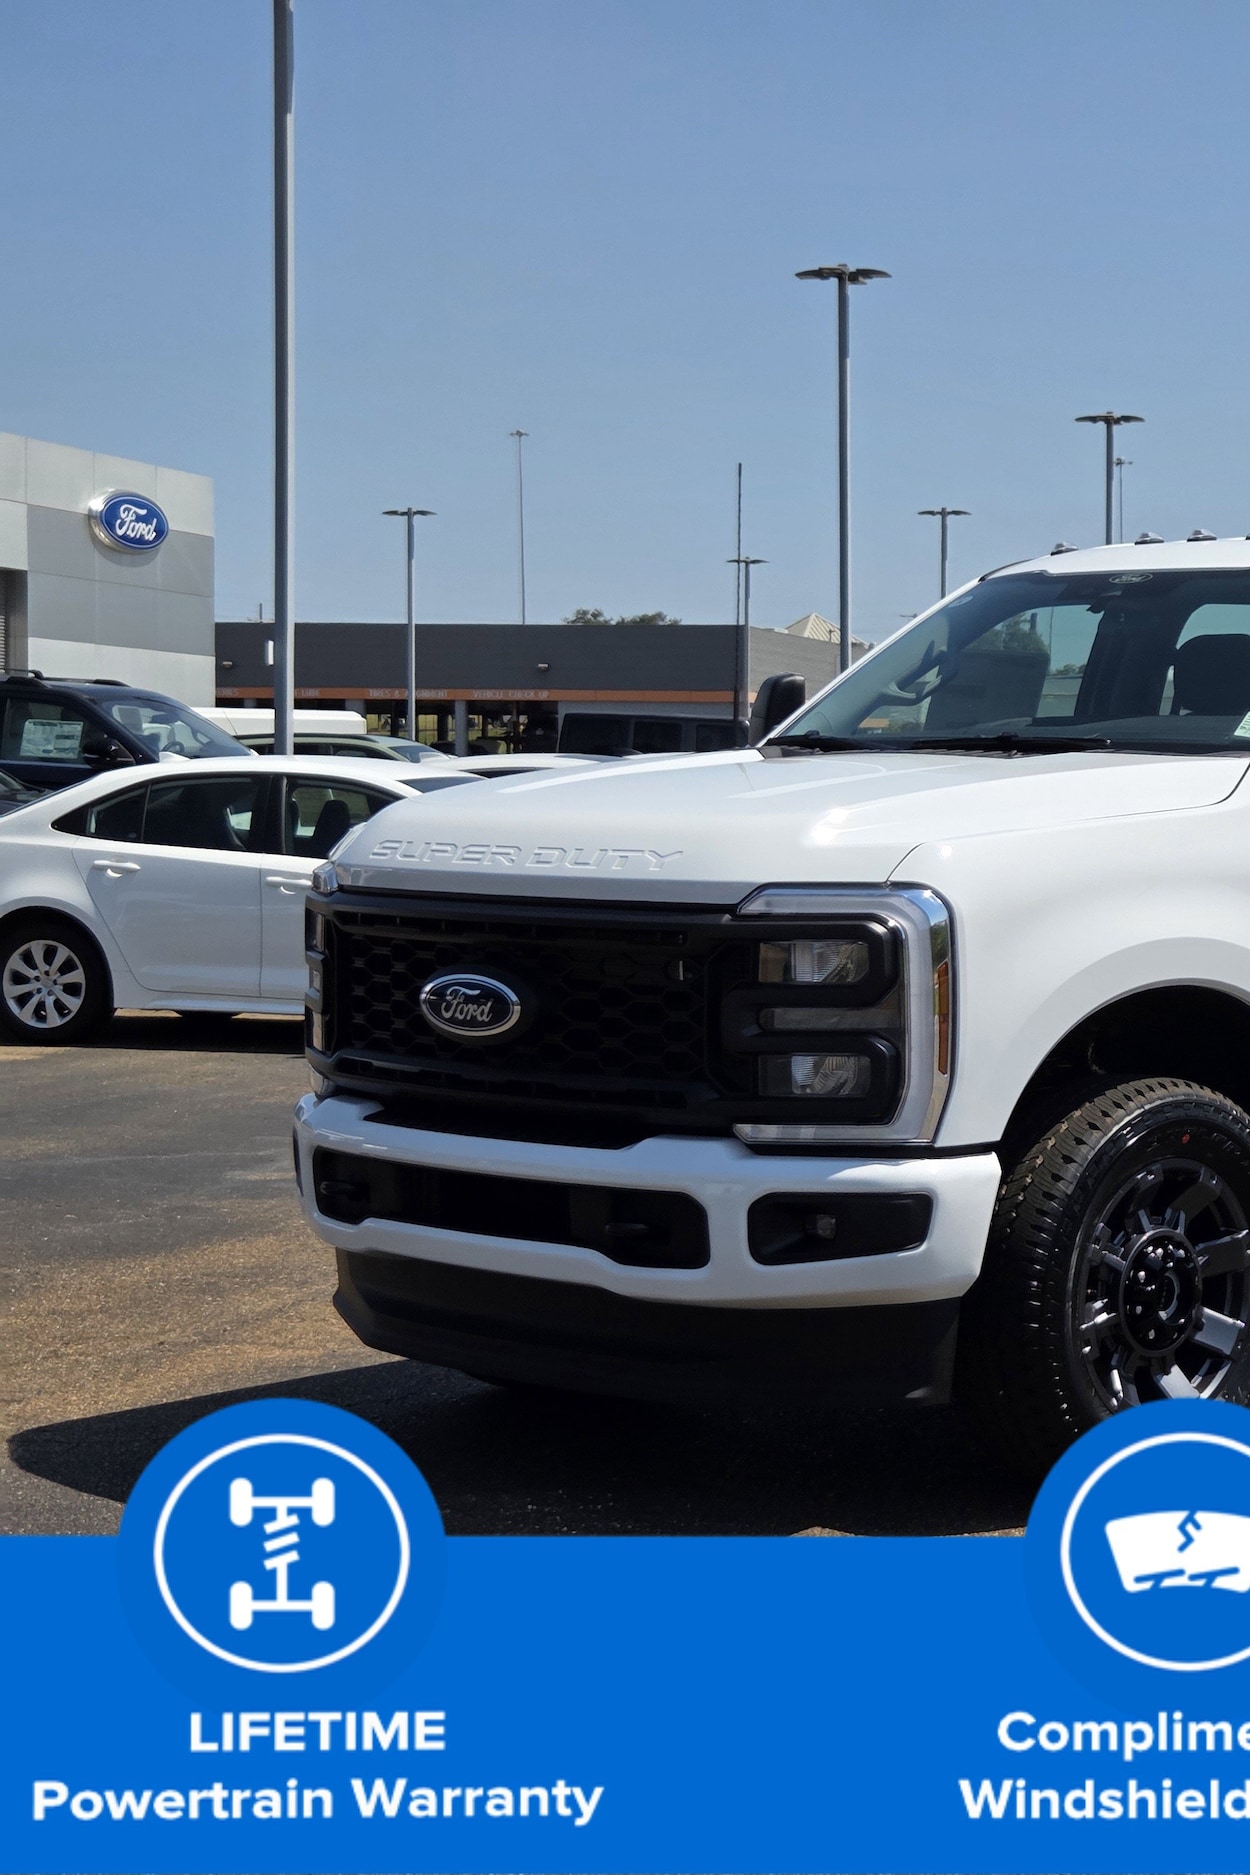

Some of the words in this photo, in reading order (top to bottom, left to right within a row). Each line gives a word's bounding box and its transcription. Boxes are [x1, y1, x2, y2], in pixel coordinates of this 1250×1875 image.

[115, 503, 157, 541] Ford
[369, 839, 522, 866] SUPER
[524, 846, 684, 871] DUTY
[441, 985, 493, 1022] Ford
